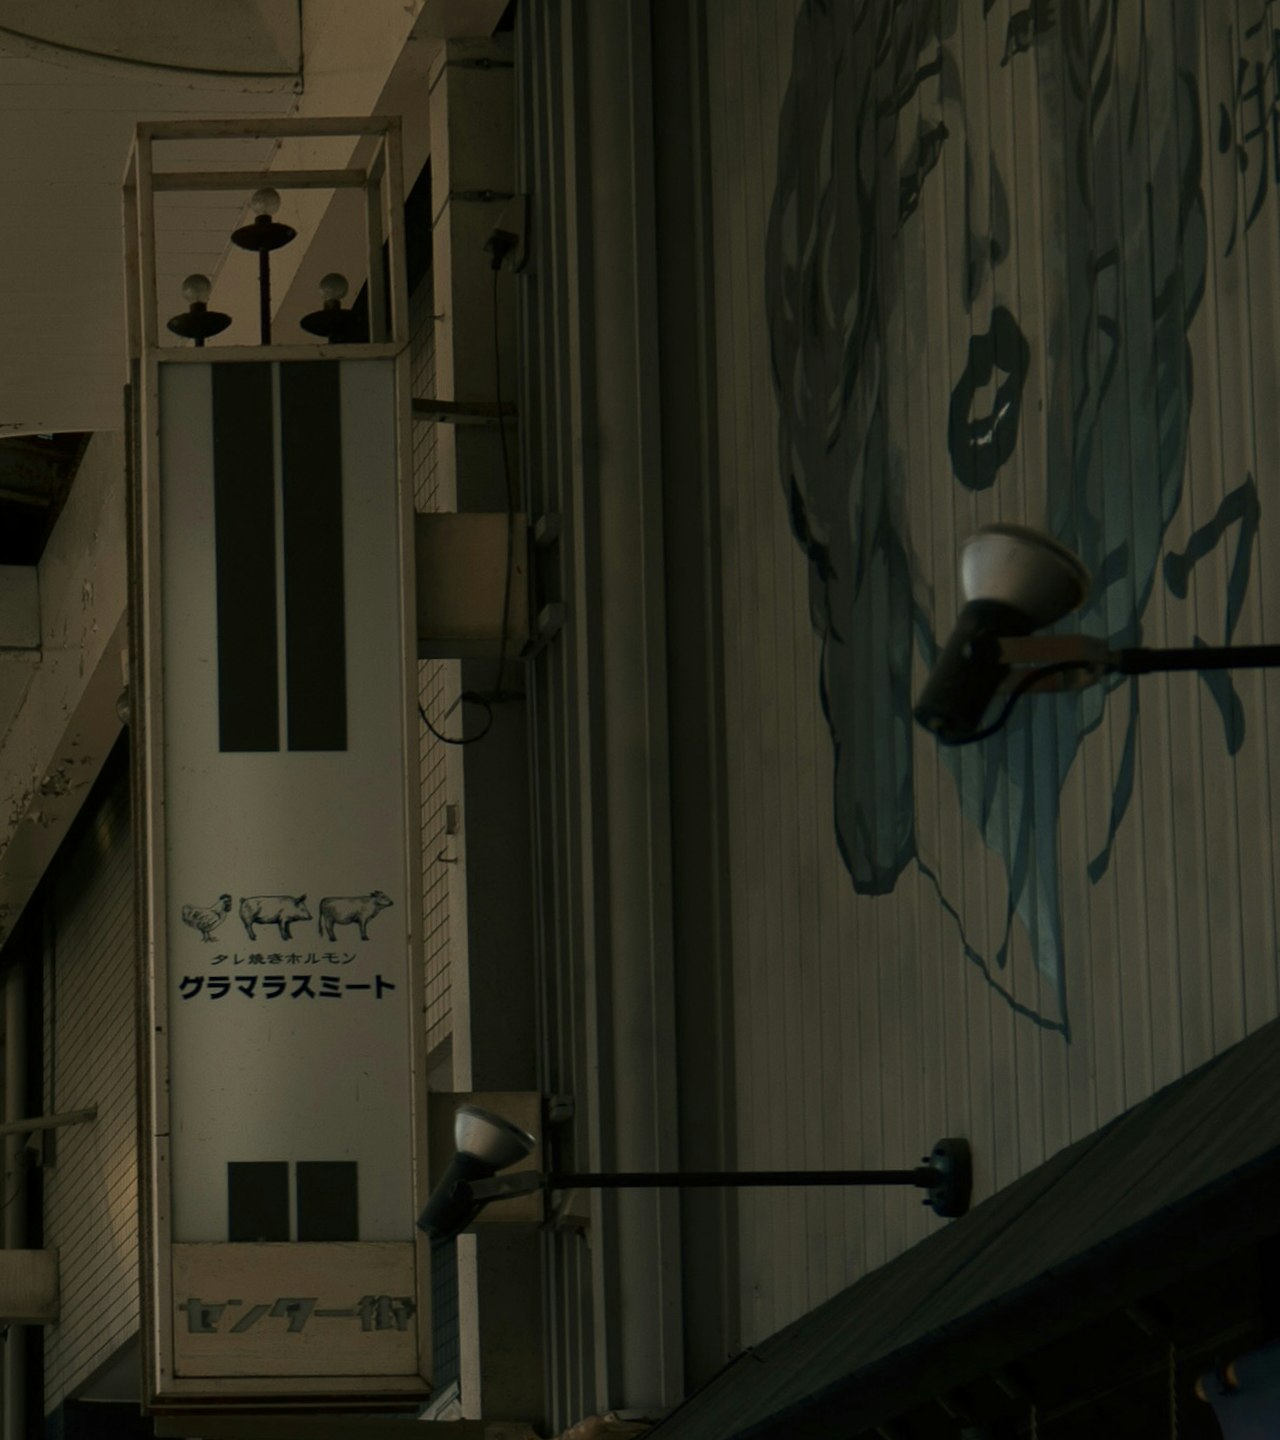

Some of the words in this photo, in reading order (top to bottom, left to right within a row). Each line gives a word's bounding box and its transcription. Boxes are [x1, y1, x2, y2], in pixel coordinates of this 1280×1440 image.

[210, 951, 358, 966] タレ焼きホルモン
[179, 973, 396, 1000] グラマラスミート
[179, 1295, 417, 1334] センター街
